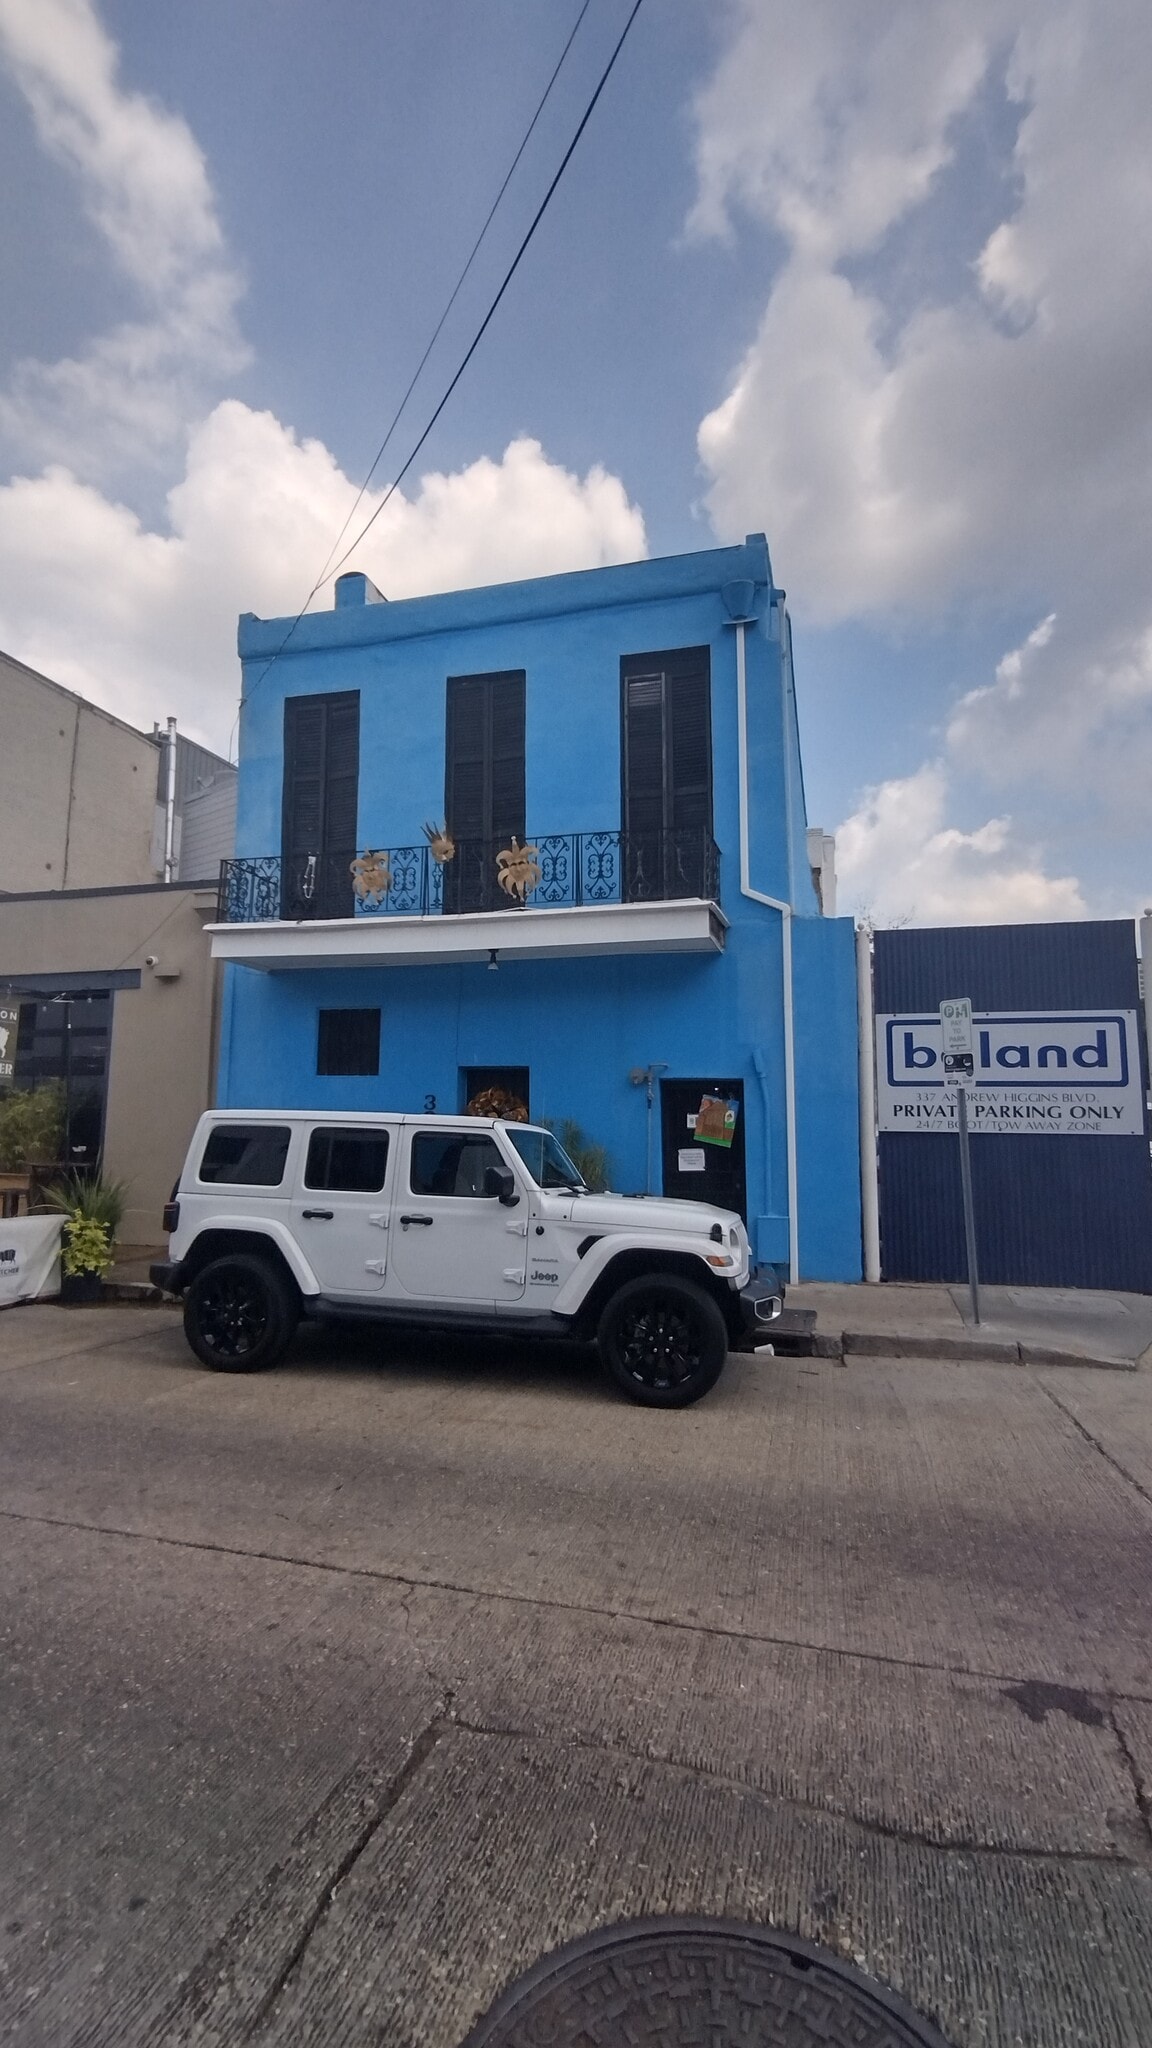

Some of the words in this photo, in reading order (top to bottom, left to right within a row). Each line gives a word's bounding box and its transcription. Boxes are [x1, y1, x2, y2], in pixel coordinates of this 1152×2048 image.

[904, 1029, 1108, 1068] bland
[916, 1093, 936, 1101] 337
[1004, 1093, 1058, 1102] HIGGINS
[893, 1104, 958, 1117] PRIVAT
[975, 1105, 1062, 1118] PARKING
[1070, 1106, 1124, 1119] ONLY
[916, 1120, 943, 1129] 24/7
[1025, 1122, 1061, 1130] AWAY
[1067, 1122, 1101, 1131] ZONE
[530, 1270, 559, 1283] Jeep
